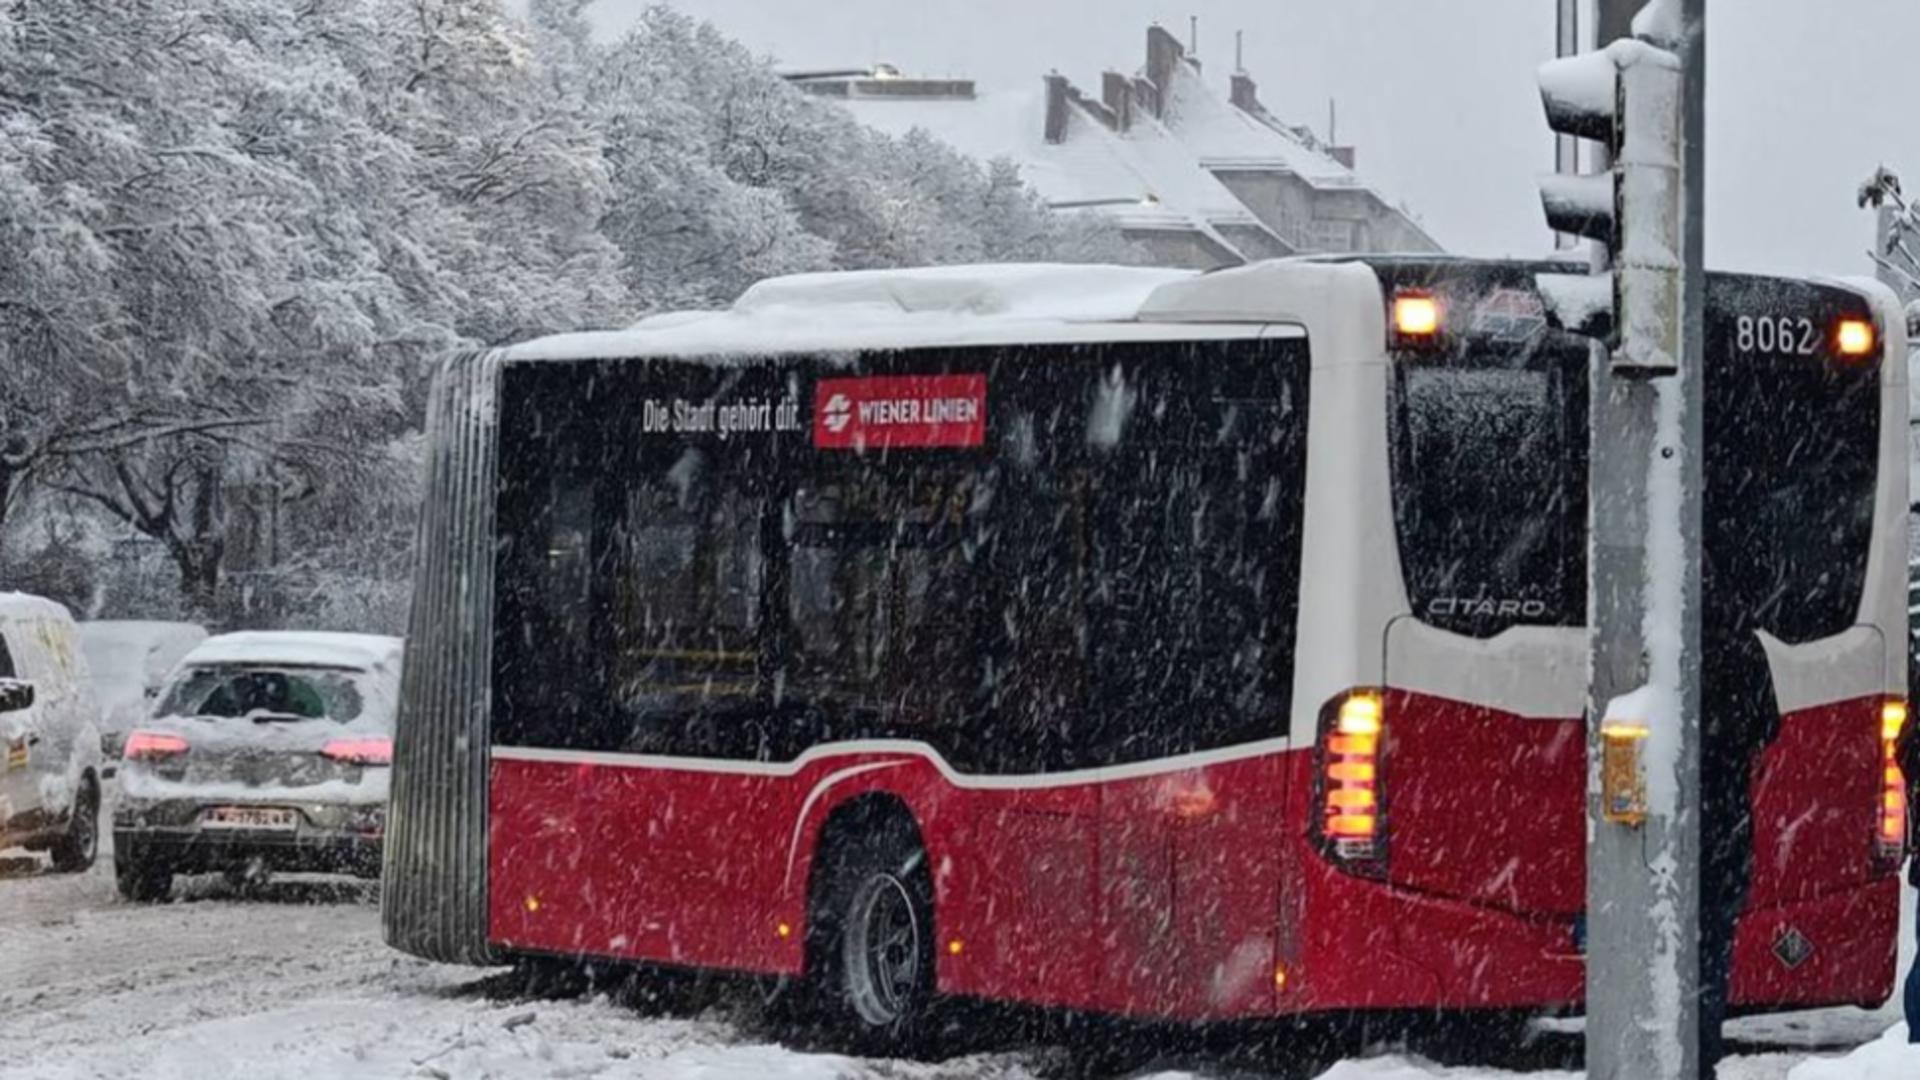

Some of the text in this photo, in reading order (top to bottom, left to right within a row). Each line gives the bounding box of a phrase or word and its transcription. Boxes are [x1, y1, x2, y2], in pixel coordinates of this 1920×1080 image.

[1737, 315, 1814, 355] 8062
[643, 397, 802, 441] Die Stadt gehört dir.
[858, 397, 979, 424] WIENER LINIEN
[1427, 597, 1546, 616] CITARO
